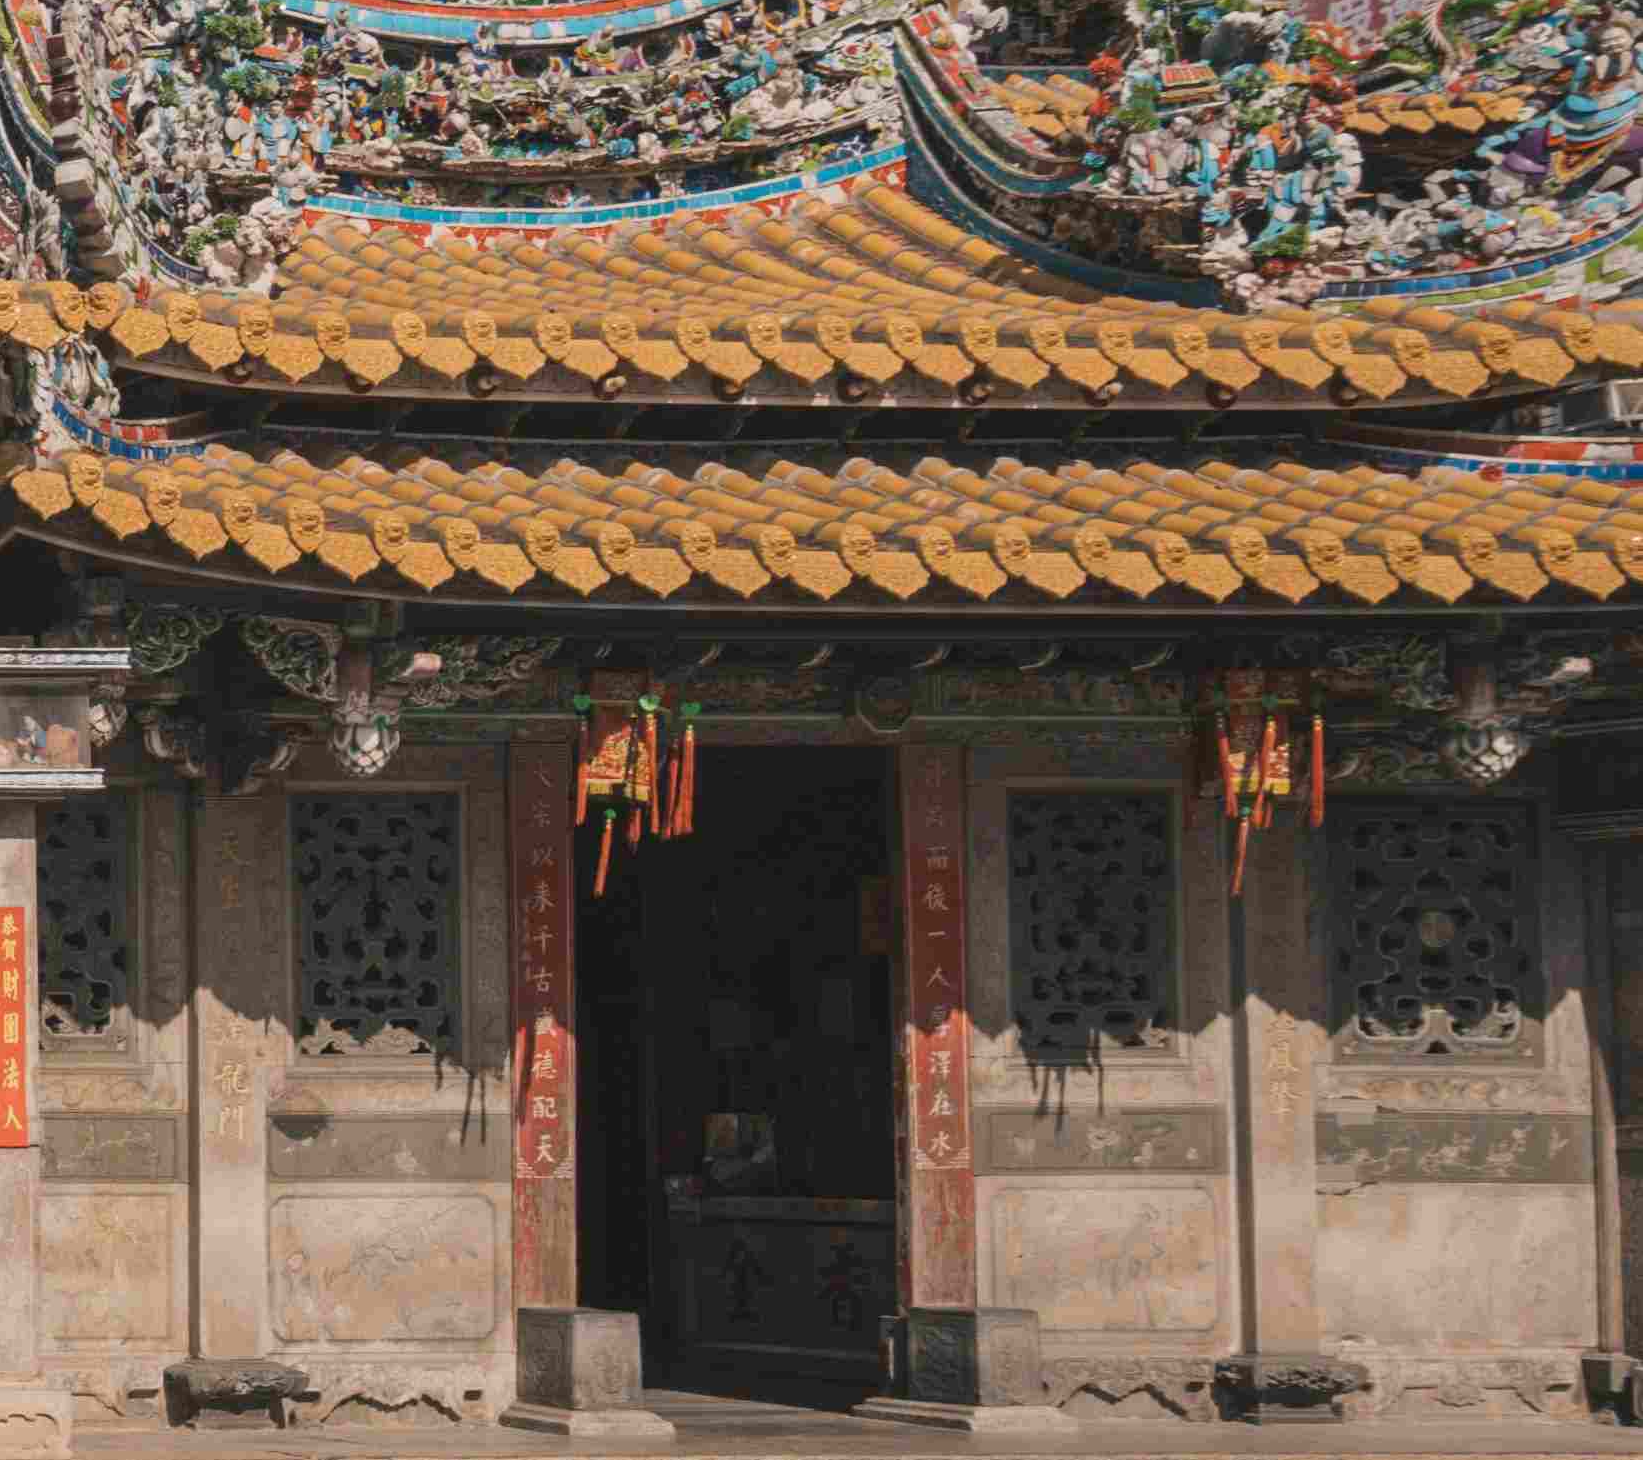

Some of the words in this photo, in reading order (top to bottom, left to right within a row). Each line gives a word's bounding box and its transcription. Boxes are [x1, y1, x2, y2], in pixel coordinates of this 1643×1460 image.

[1, 913, 23, 1131] 恭賀財團法人
